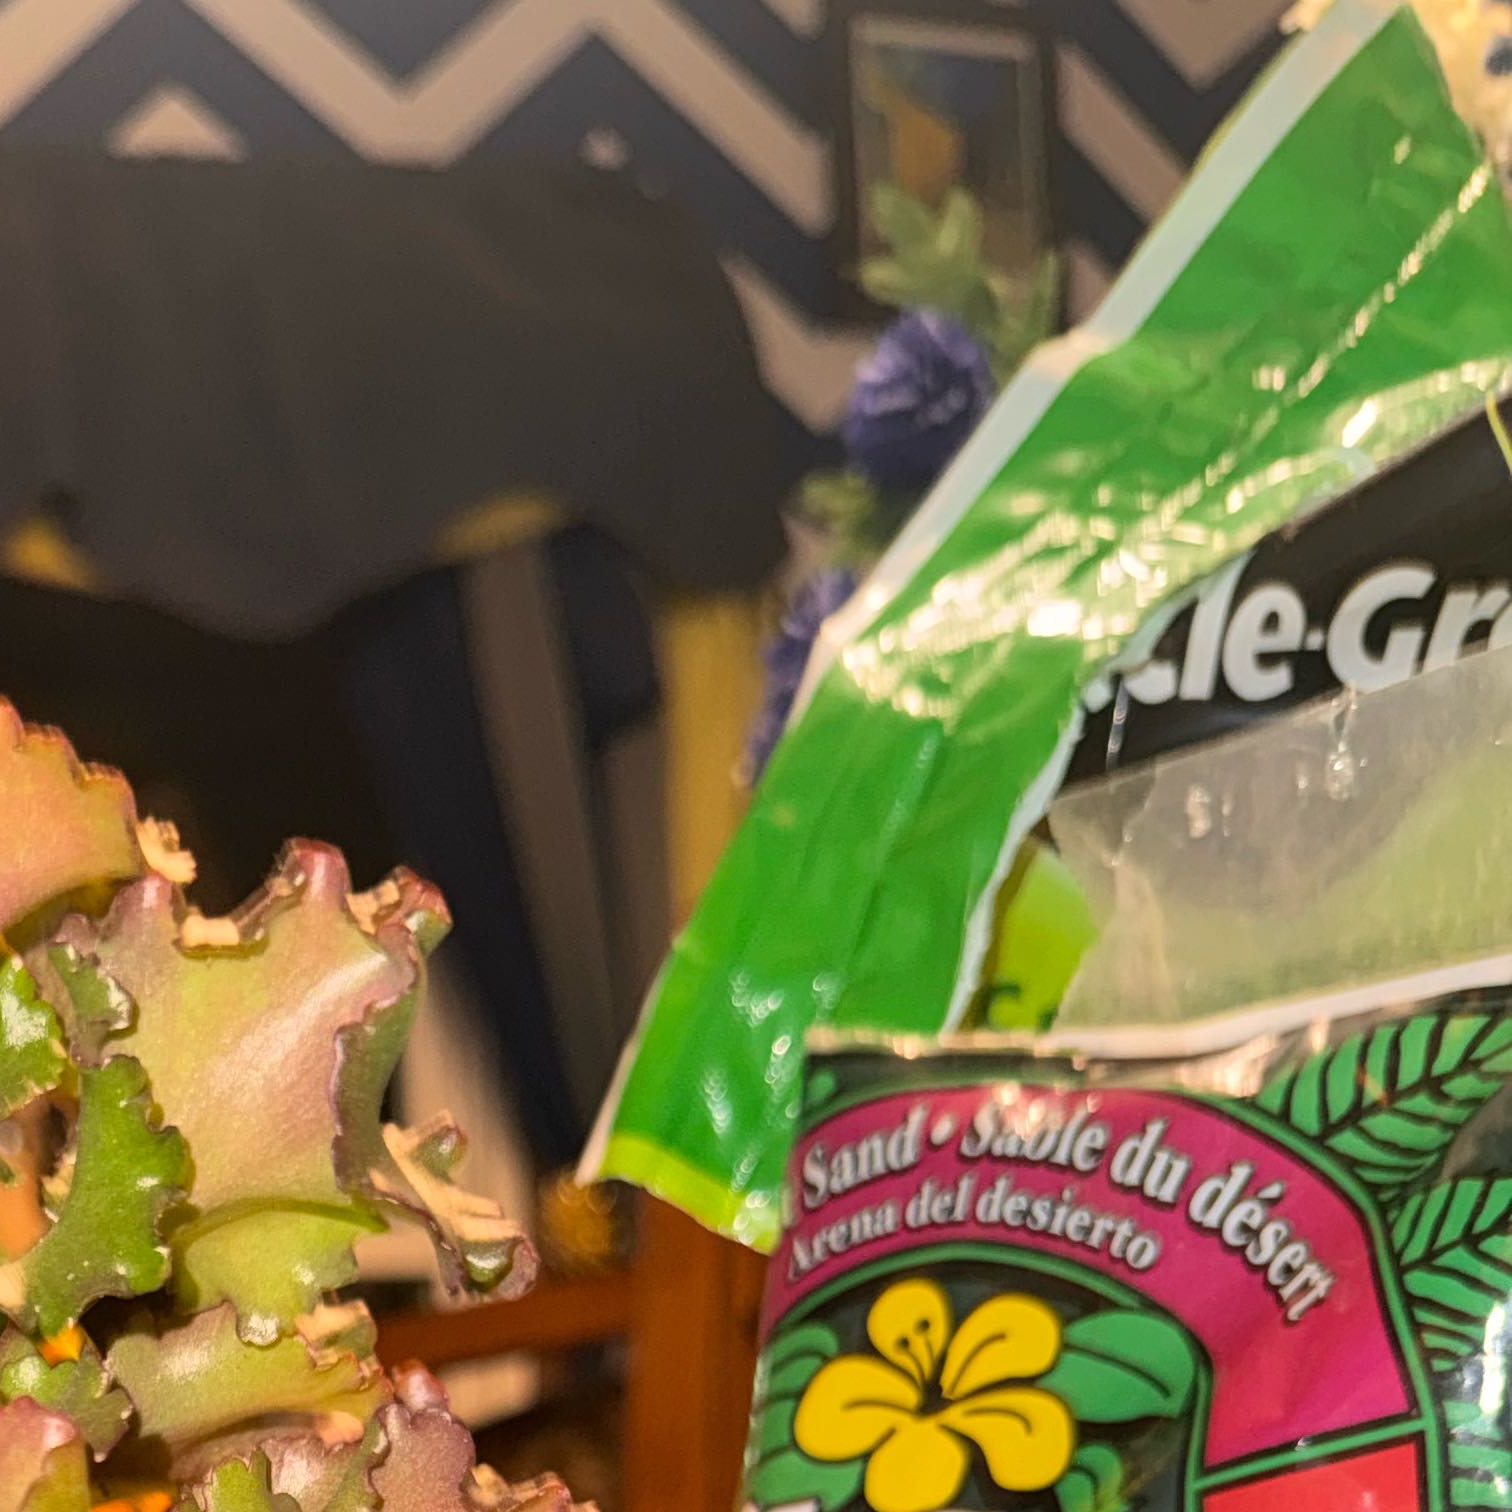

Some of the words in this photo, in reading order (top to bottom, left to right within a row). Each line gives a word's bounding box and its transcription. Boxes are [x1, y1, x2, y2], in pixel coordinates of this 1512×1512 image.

[1082, 564, 1512, 713] le-Gr
[803, 1103, 928, 1209] Sand
[1111, 1117, 1189, 1205] du
[1190, 1161, 1337, 1322] désert
[905, 1171, 977, 1229] del
[976, 1174, 1161, 1271] desierto
